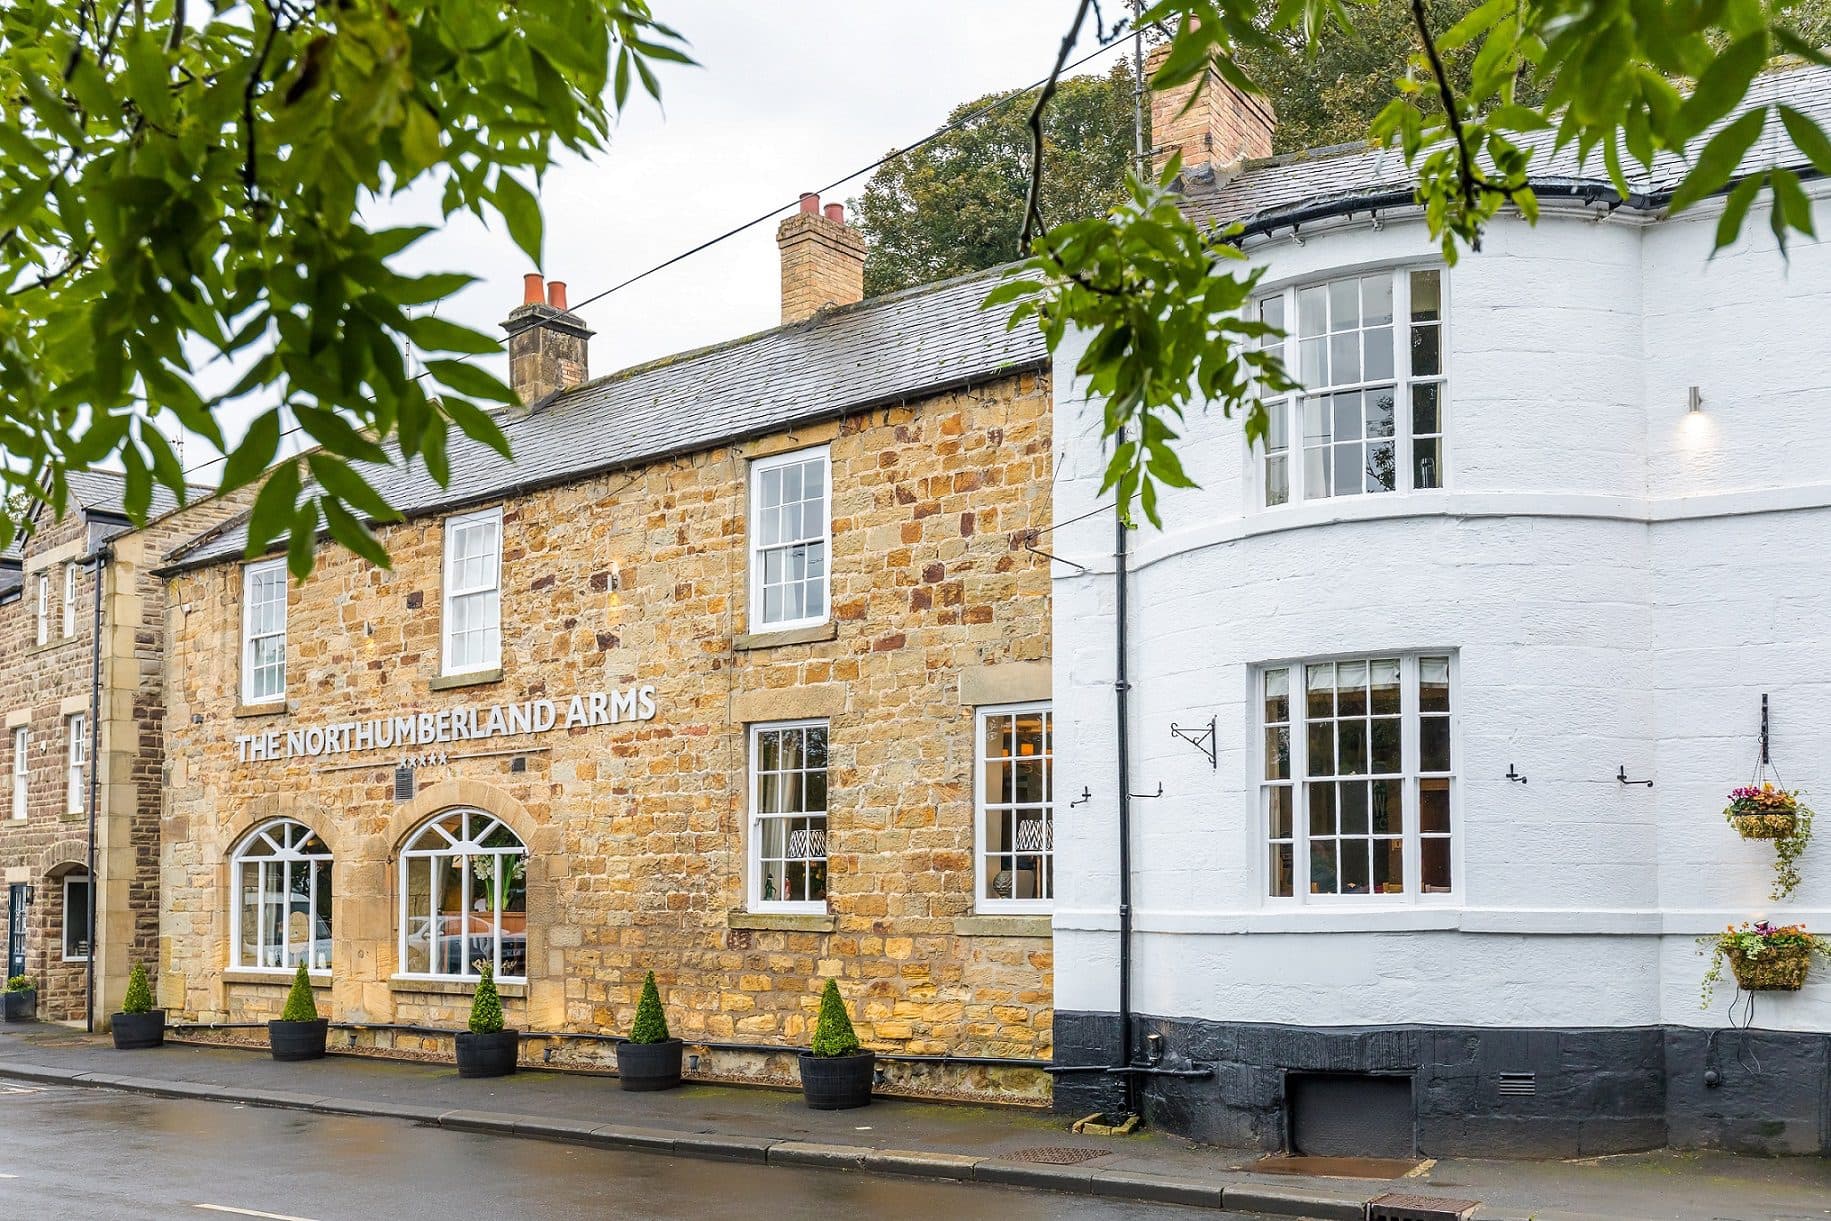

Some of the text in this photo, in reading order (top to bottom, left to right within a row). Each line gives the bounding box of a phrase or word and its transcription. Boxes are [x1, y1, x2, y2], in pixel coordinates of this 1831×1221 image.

[235, 685, 656, 763] THE NORTHUMBERLAND ARMS
